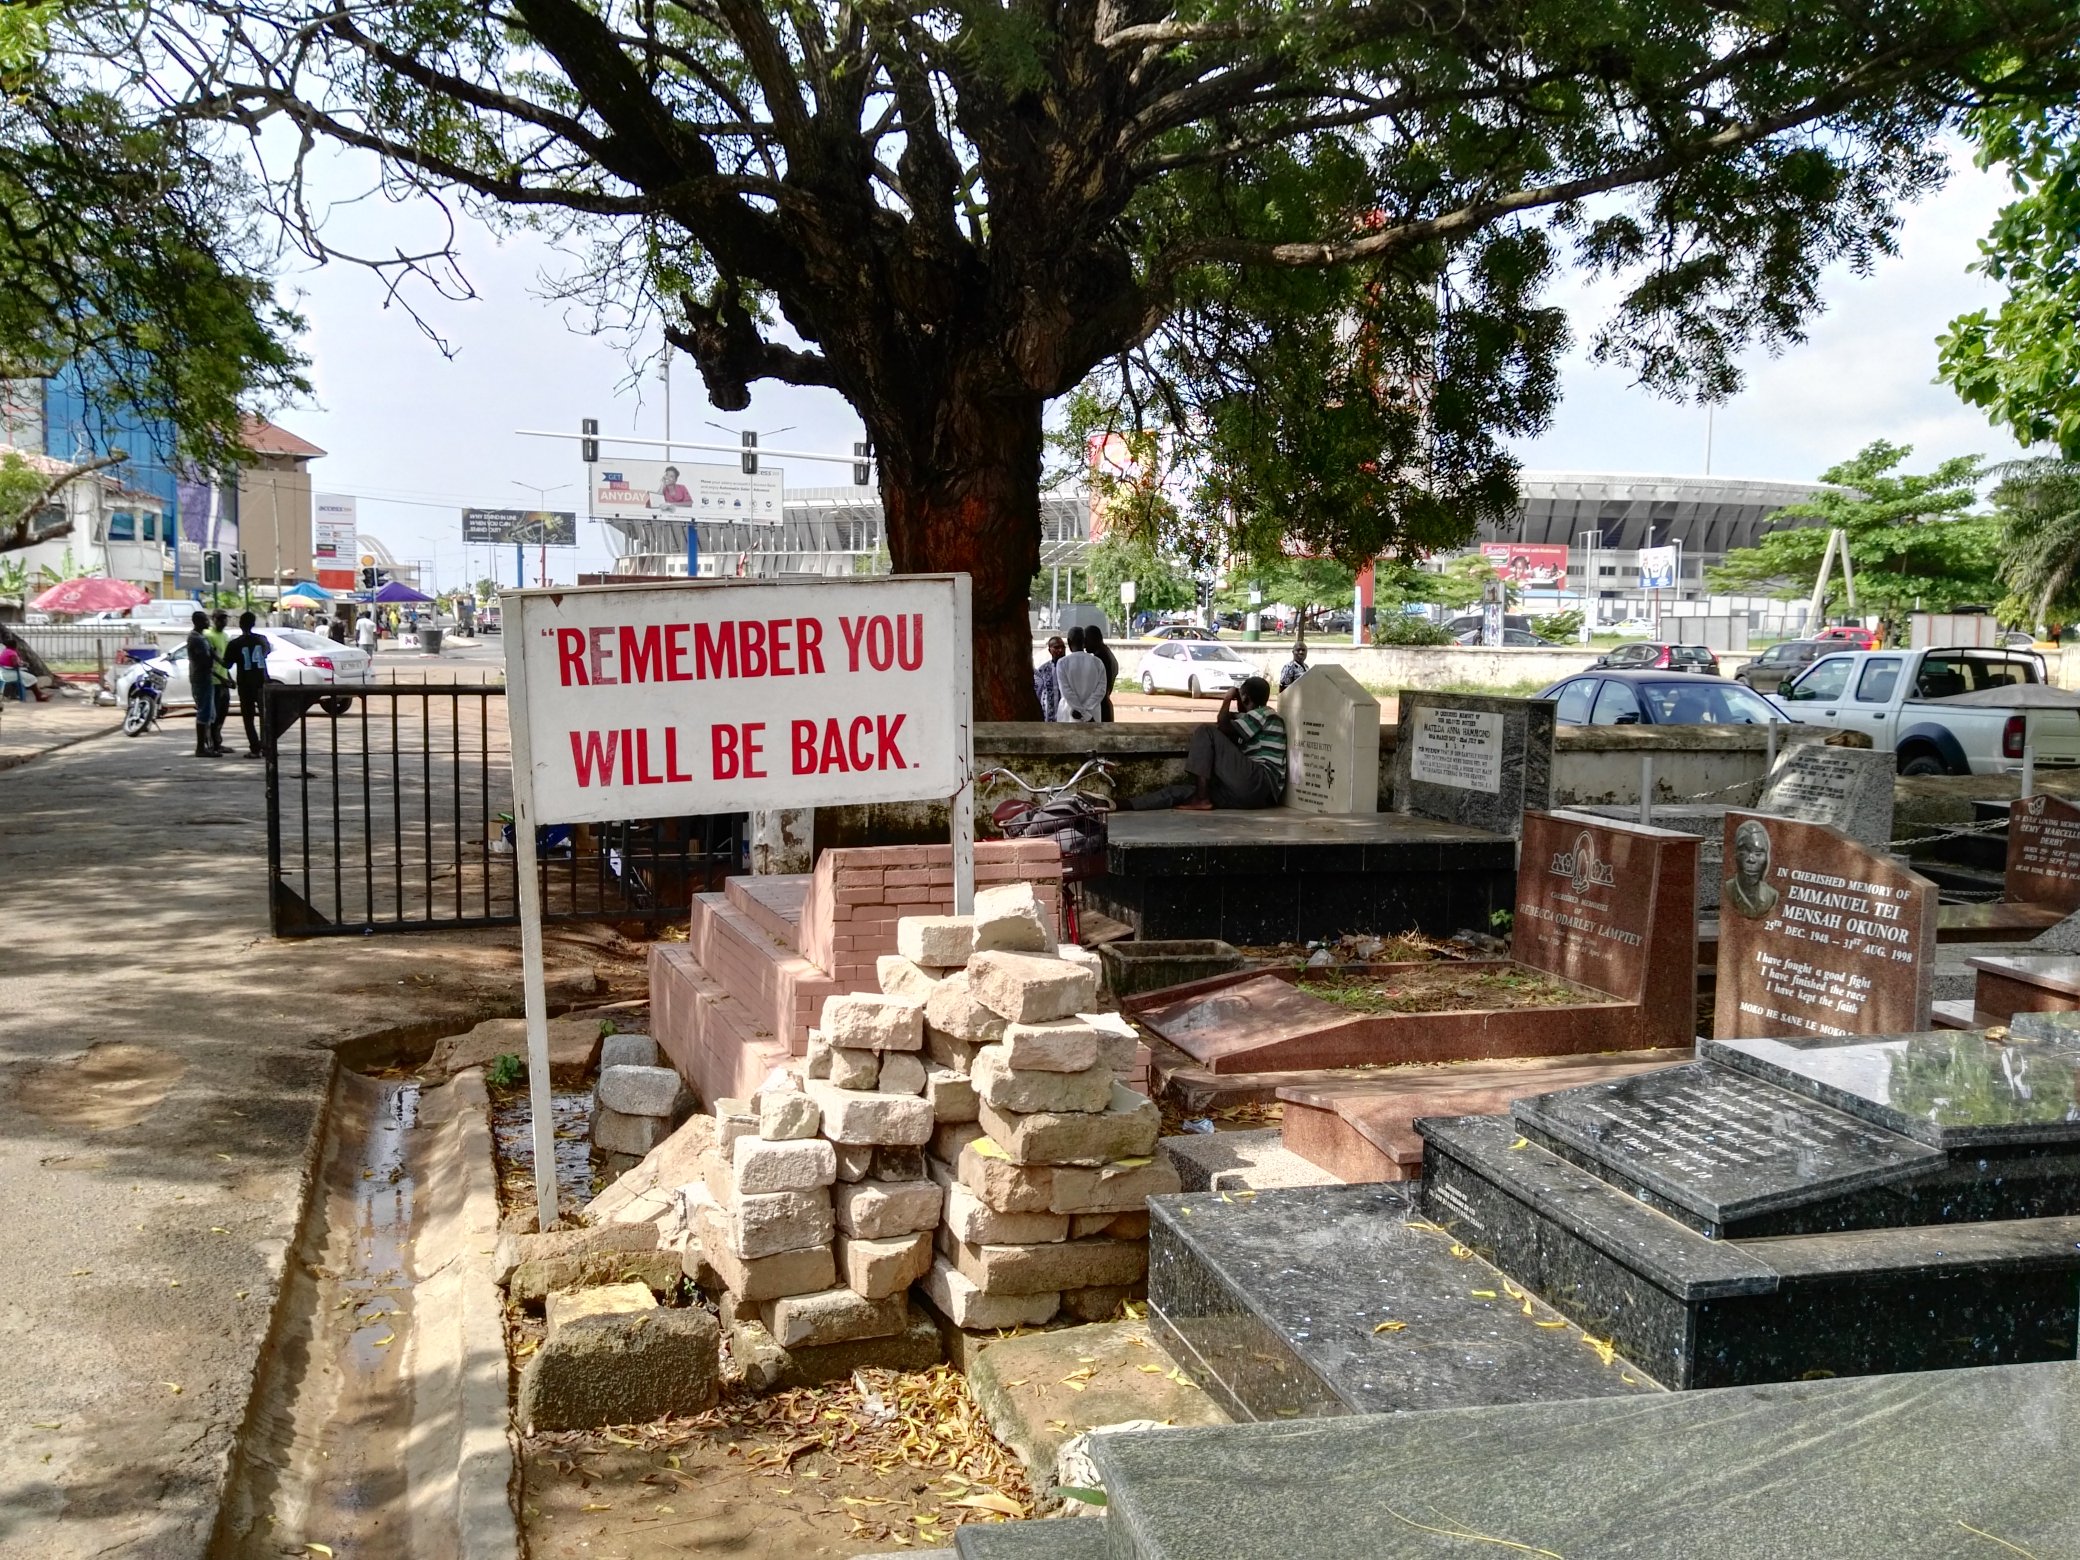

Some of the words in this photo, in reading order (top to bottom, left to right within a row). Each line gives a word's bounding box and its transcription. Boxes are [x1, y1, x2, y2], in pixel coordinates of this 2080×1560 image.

[600, 491, 645, 501] ANYDAY
[242, 645, 265, 670] 14
[838, 613, 924, 672] YOU
[1447, 727, 1460, 735] ANNA
[570, 726, 692, 788] WILL
[712, 722, 767, 780] BE
[791, 714, 920, 776] BACK.
[2040, 837, 2066, 847] DERBY
[1777, 867, 1789, 877] IN
[1791, 870, 1846, 888] CHERISHED
[1847, 880, 1893, 897] MEMORY
[1896, 889, 1912, 900] OF
[1788, 885, 1869, 914] EMMANUEL
[1873, 902, 1901, 920] TEI
[1520, 904, 1554, 921] REBECCA
[1556, 913, 1596, 933] ODARLEY
[1598, 925, 1643, 947] LAMPTEY
[1782, 904, 1842, 929] MENSAH
[1846, 918, 1909, 944] OKUNOR
[1784, 925, 1806, 938] DEC.
[1810, 931, 1829, 944] 1948
[1863, 943, 1886, 958] AUG.
[1891, 950, 1913, 963] 1998
[1756, 951, 1762, 962] I
[1763, 952, 1782, 967] have
[1783, 958, 1813, 975] fought
[1816, 968, 1821, 977] a
[1823, 969, 1846, 982] good
[1849, 975, 1871, 989] fight
[1760, 966, 1766, 976] I
[1769, 968, 1789, 982] have
[1791, 974, 1826, 992] finished
[1829, 984, 1844, 997] the
[1846, 991, 1867, 1002] race
[1766, 981, 1771, 991] I
[1774, 982, 1794, 997] have
[1797, 989, 1816, 1005] kept
[1819, 995, 1833, 1008] the
[1835, 1000, 1858, 1014] faith
[1739, 1001, 1764, 1015] MOKO
[1766, 1008, 1778, 1020] HE
[1780, 1012, 1803, 1027] SANE
[1805, 1019, 1817, 1031] LE
[1754, 1089, 1783, 1099] Lord
[1778, 1099, 1823, 1114] himself
